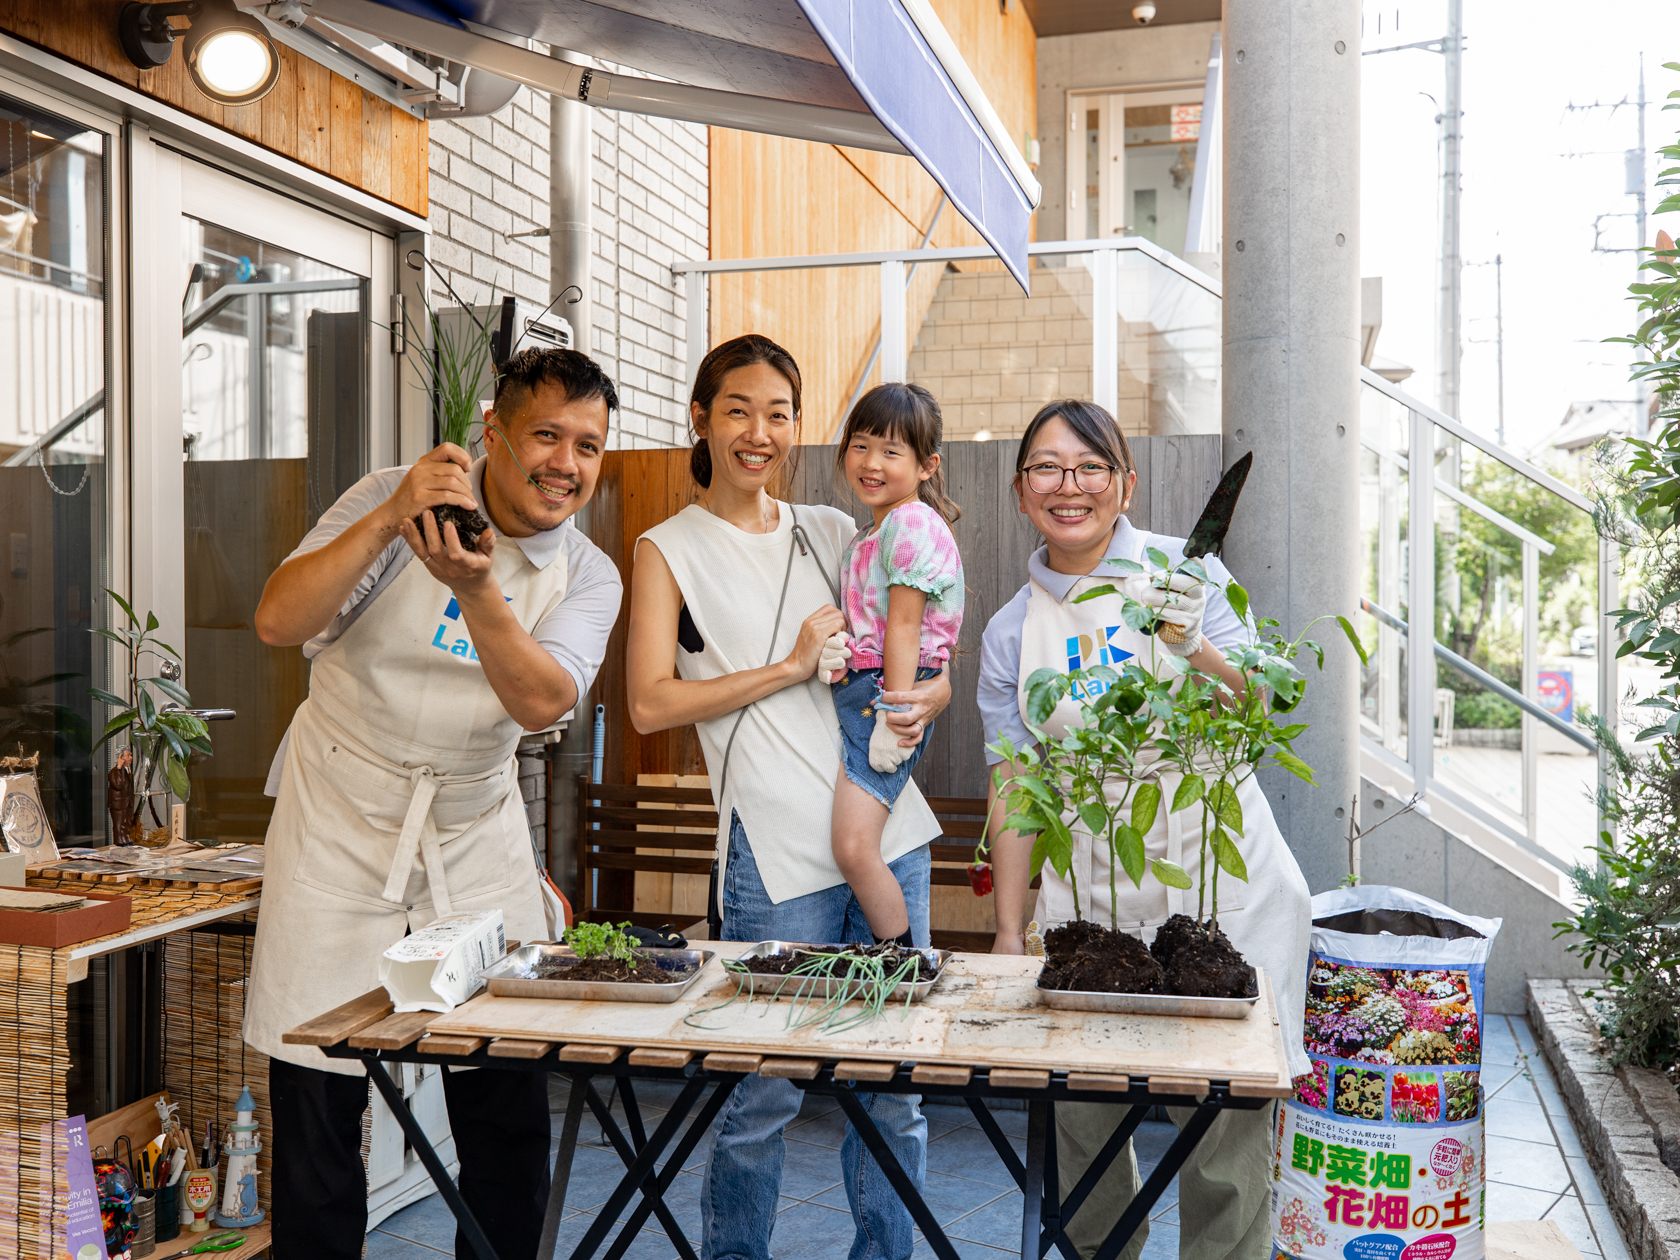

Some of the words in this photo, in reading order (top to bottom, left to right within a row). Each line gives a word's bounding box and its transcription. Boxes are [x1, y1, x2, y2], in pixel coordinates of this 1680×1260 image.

[82, 1188, 91, 1196] in
[67, 1197, 93, 1211] Emilia
[1324, 1185, 1471, 1231] 花畑の土
